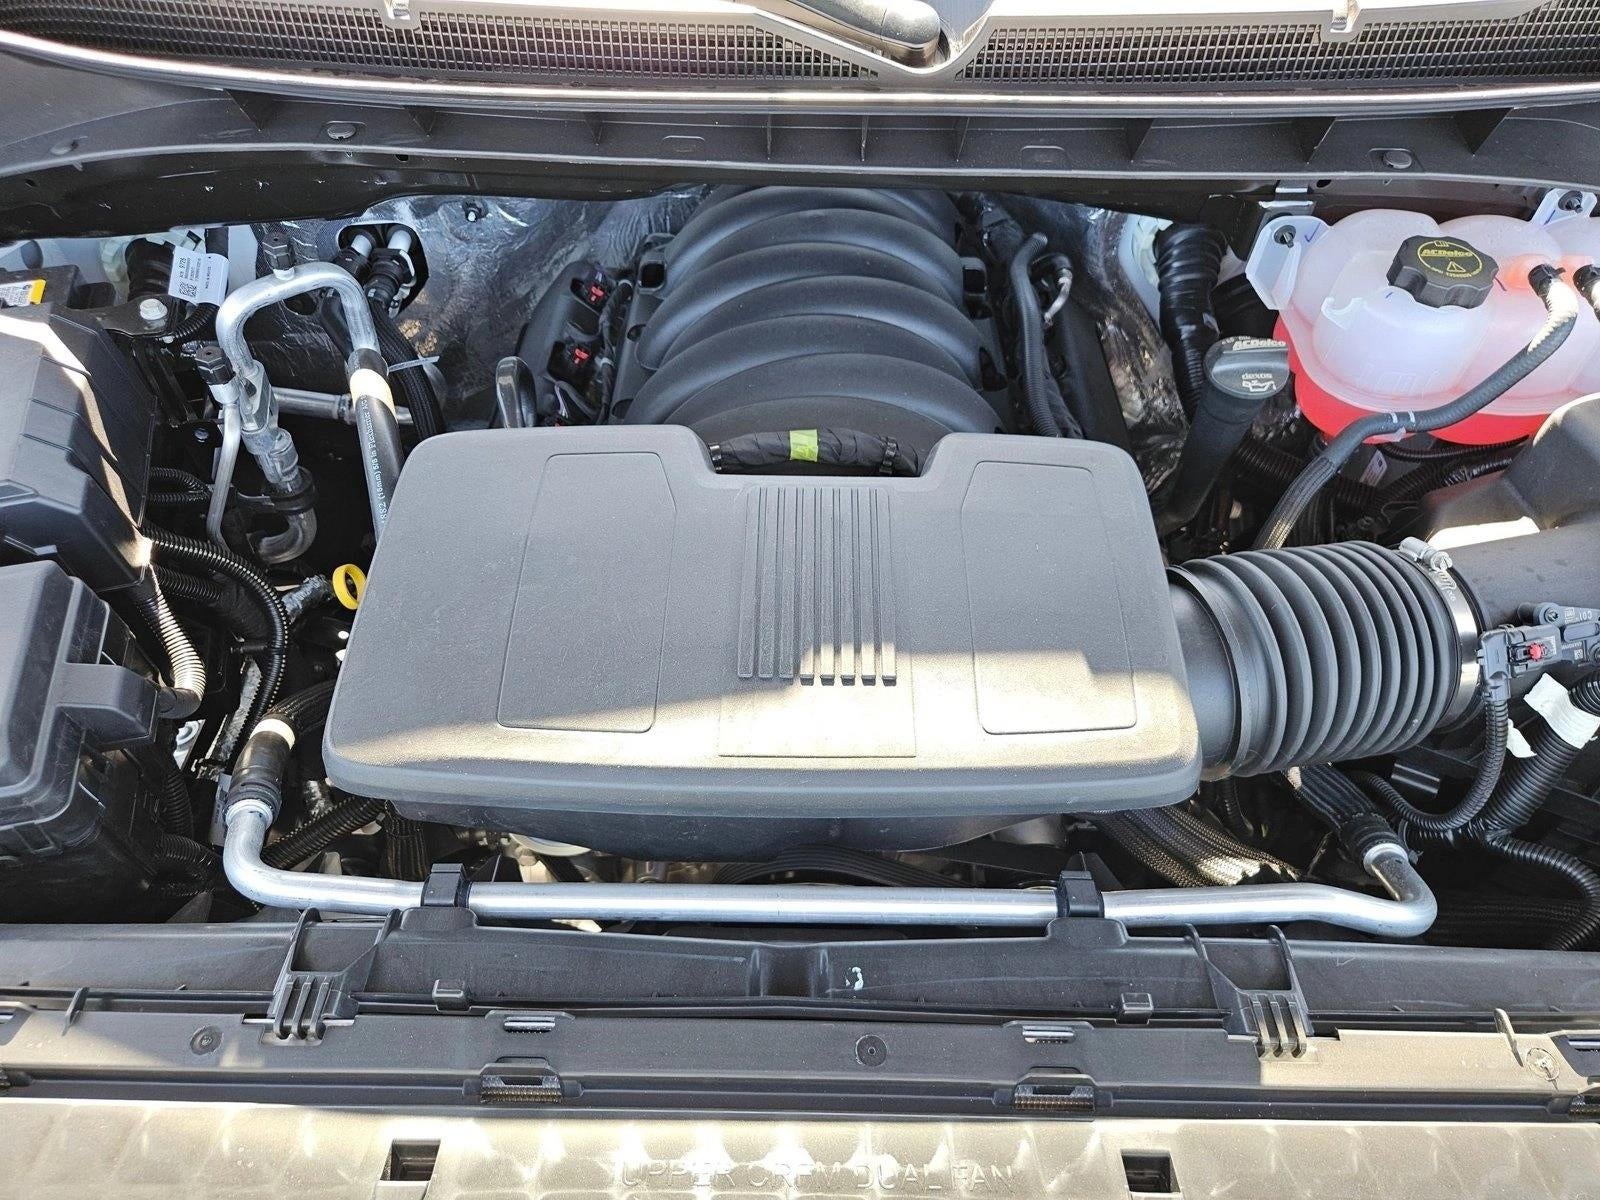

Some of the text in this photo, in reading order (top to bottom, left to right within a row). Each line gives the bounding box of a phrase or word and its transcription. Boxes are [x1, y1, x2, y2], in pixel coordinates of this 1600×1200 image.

[1232, 338, 1287, 351] ACDelco
[1242, 372, 1272, 380] dexos
[378, 502, 388, 524] 882
[621, 1161, 737, 1187] UPPER
[855, 1163, 943, 1190] DUAL
[951, 1163, 1017, 1194] FAN
